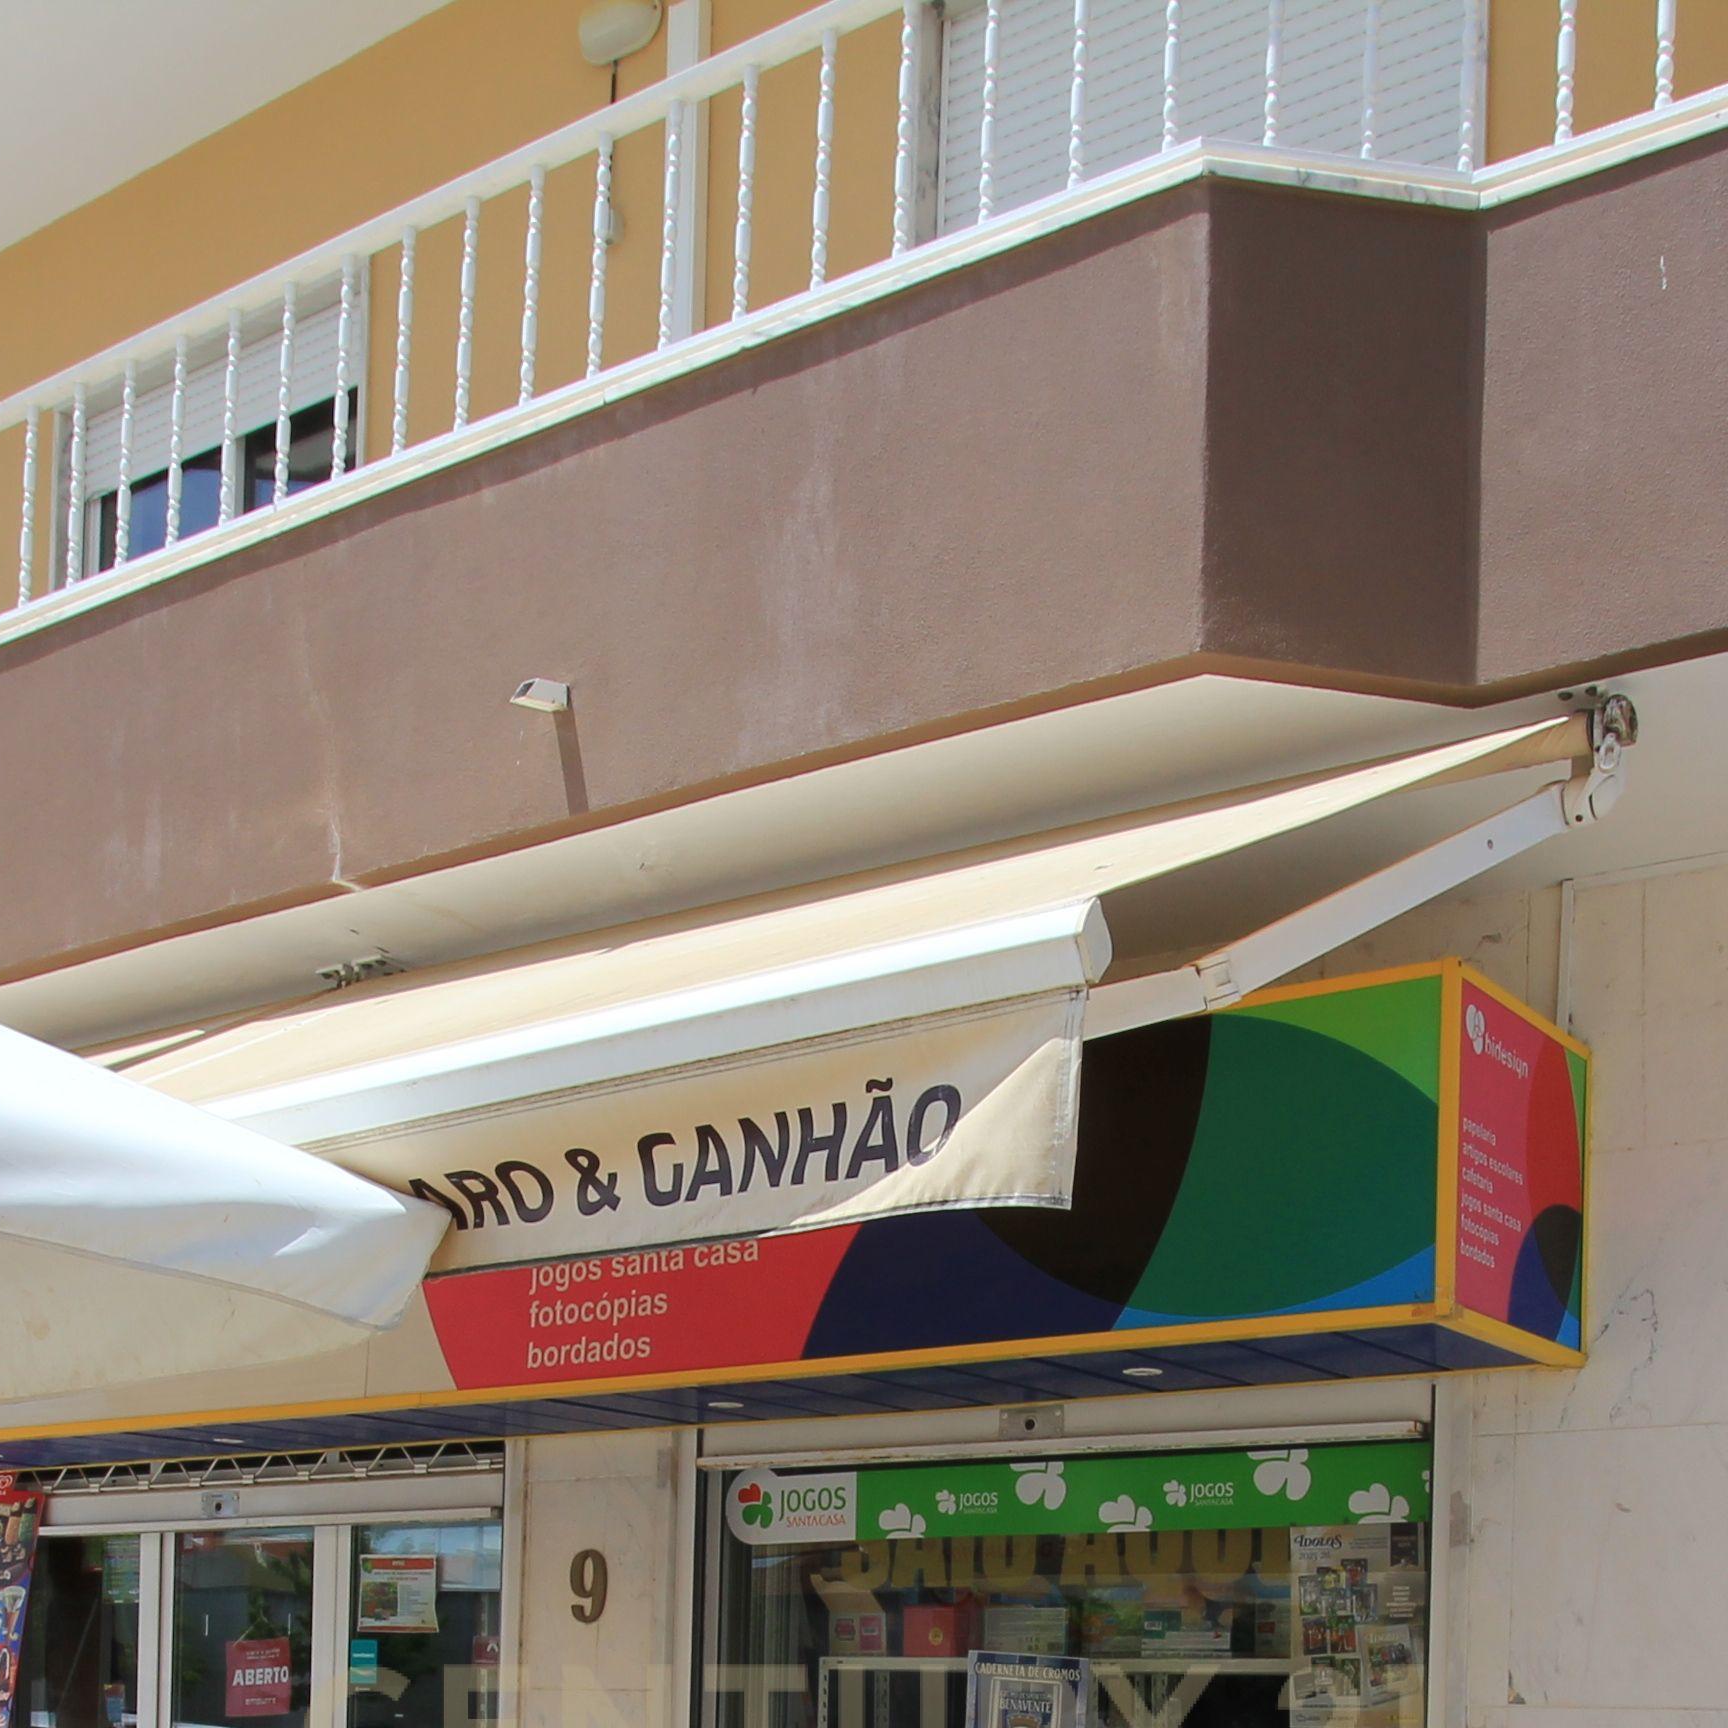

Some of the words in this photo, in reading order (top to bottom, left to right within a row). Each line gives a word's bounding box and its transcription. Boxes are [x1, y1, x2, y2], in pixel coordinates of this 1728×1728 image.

[564, 1148, 620, 1217] &
[636, 1077, 963, 1208] GANHÃO
[528, 1257, 603, 1295] jogos
[611, 1245, 685, 1279] santa
[693, 1238, 760, 1271] casa
[528, 1291, 669, 1328] fotocópias
[526, 1333, 652, 1370] bordados
[778, 1486, 847, 1521] JOGOS
[959, 1491, 999, 1511] JOGOS
[1189, 1482, 1235, 1503] JOGOS
[570, 1548, 609, 1624] 9
[232, 1665, 289, 1687] ABERTO
[1027, 1666, 1040, 1679] DE
[1041, 1667, 1082, 1682] CROMOS
